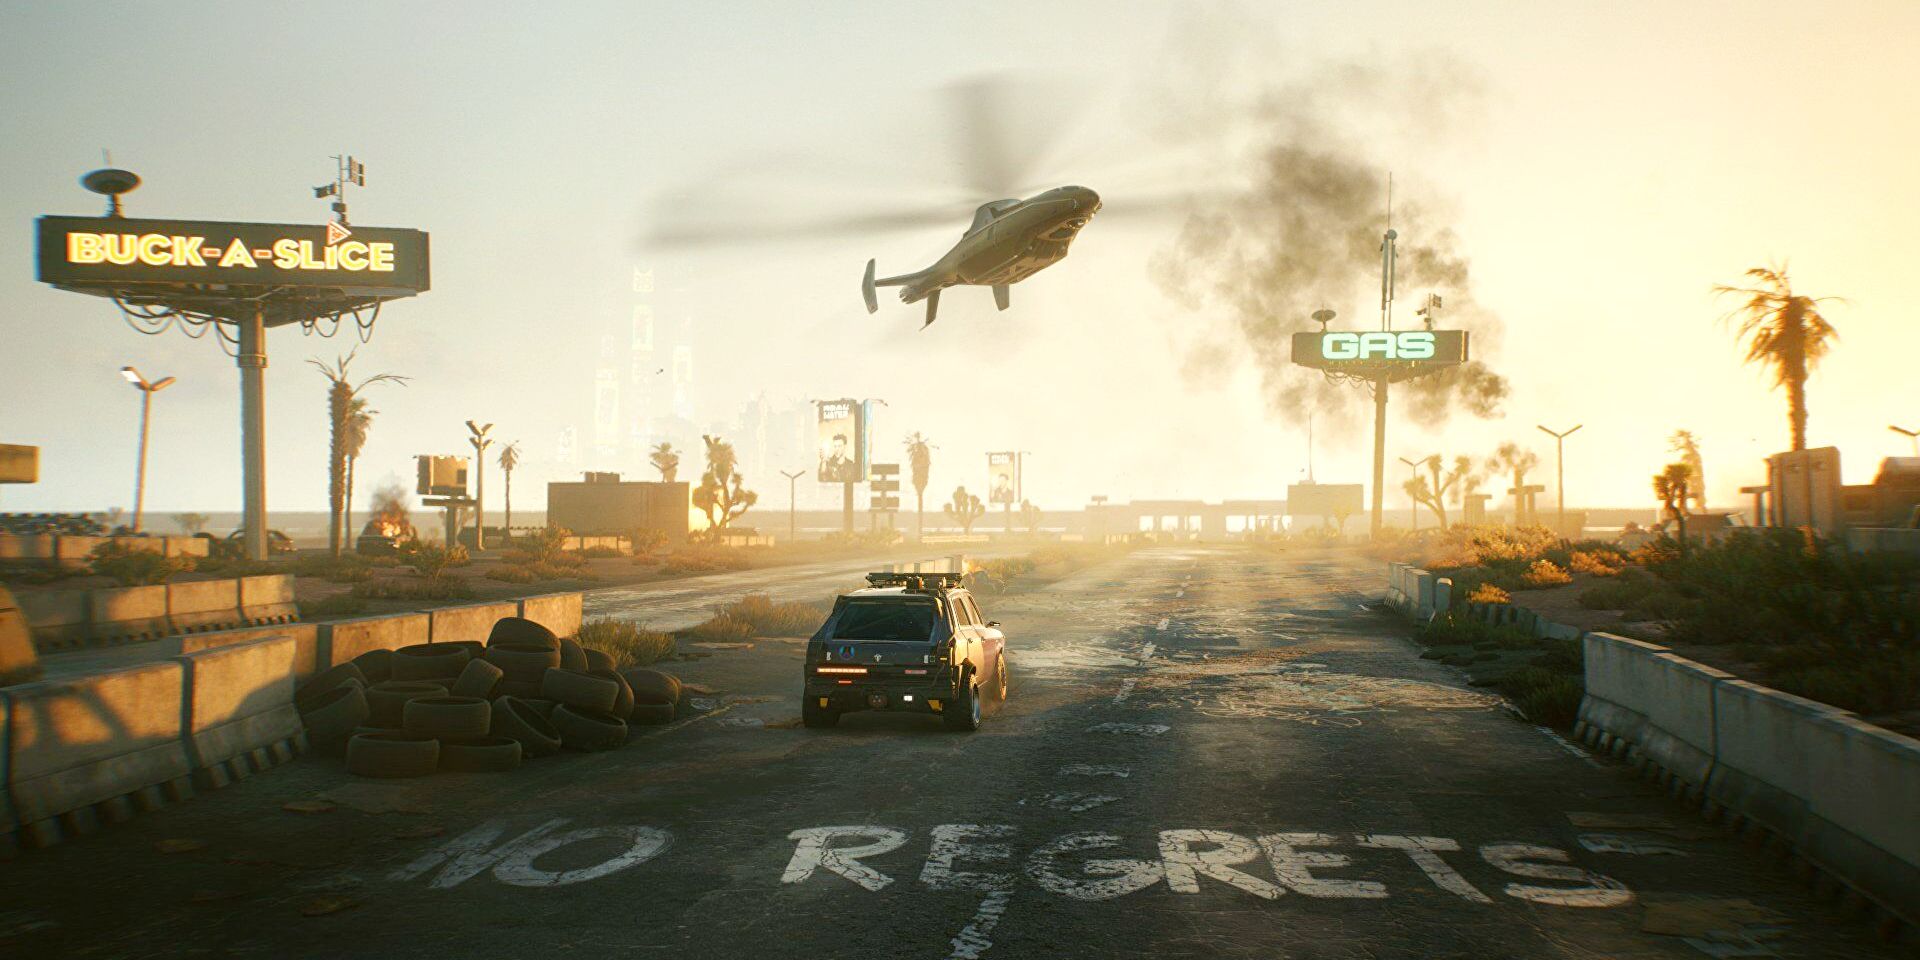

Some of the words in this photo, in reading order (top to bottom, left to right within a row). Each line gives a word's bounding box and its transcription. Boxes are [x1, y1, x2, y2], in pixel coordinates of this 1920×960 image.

[1322, 331, 1436, 360] GAS
[387, 817, 674, 887] NO
[780, 825, 1634, 908] REGRETS
